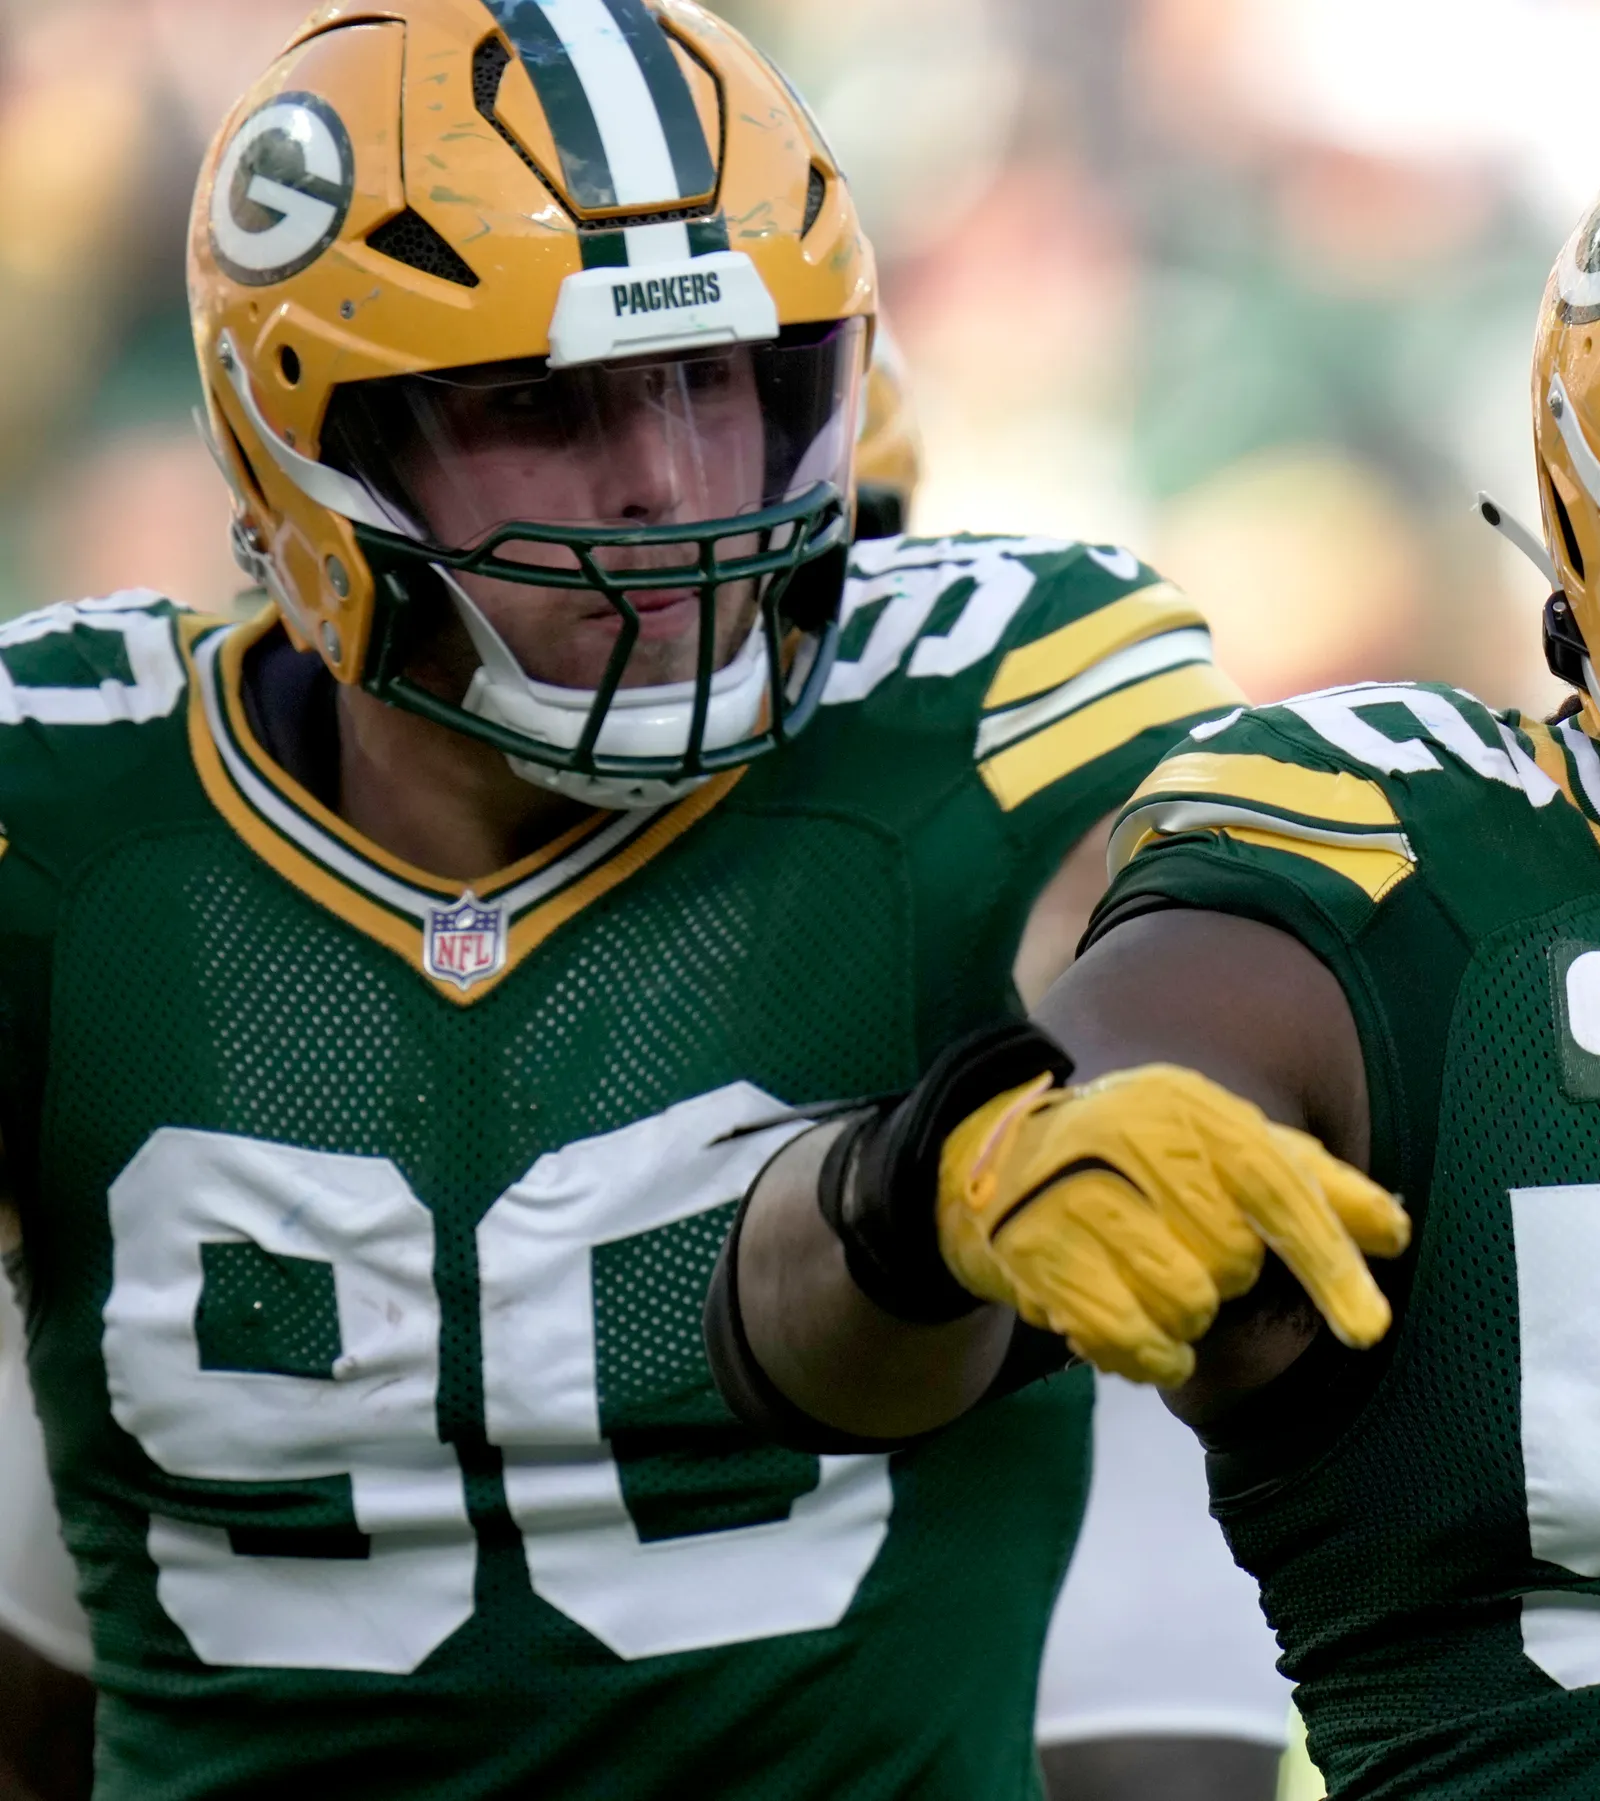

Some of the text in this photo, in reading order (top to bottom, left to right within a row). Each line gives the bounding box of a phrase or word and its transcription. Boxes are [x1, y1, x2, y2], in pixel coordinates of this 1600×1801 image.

[211, 104, 338, 268] G
[611, 271, 721, 317] PACKERS
[437, 932, 491, 973] NFL
[102, 1080, 893, 1675] 90
